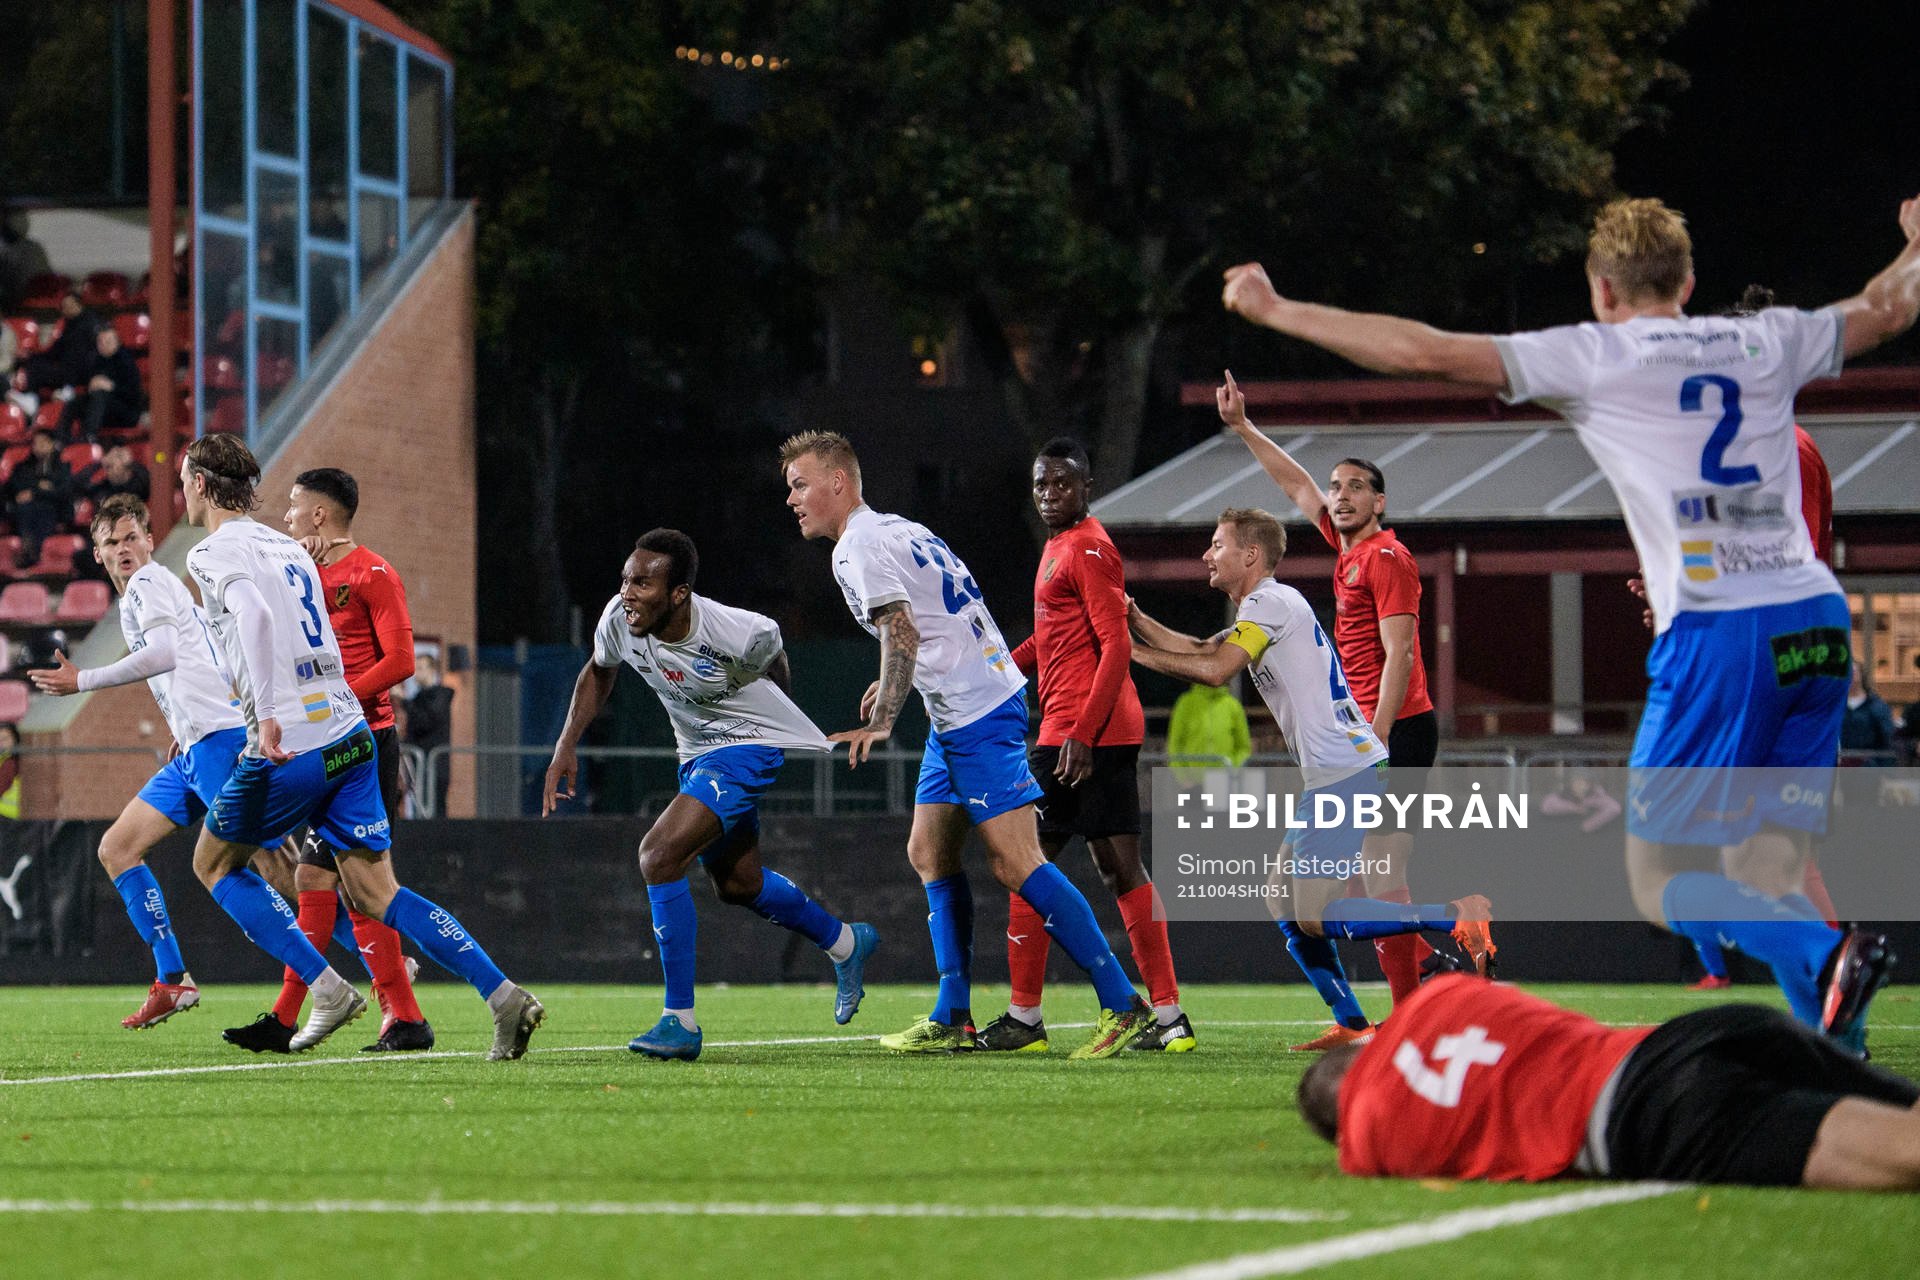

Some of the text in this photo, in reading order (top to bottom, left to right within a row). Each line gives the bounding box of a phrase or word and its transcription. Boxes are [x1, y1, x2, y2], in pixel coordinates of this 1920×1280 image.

[1680, 373, 1762, 487] 2
[284, 563, 324, 648] 3
[326, 746, 360, 773] akea
[429, 908, 475, 953] 4 office
[1394, 1025, 1507, 1109] 4
